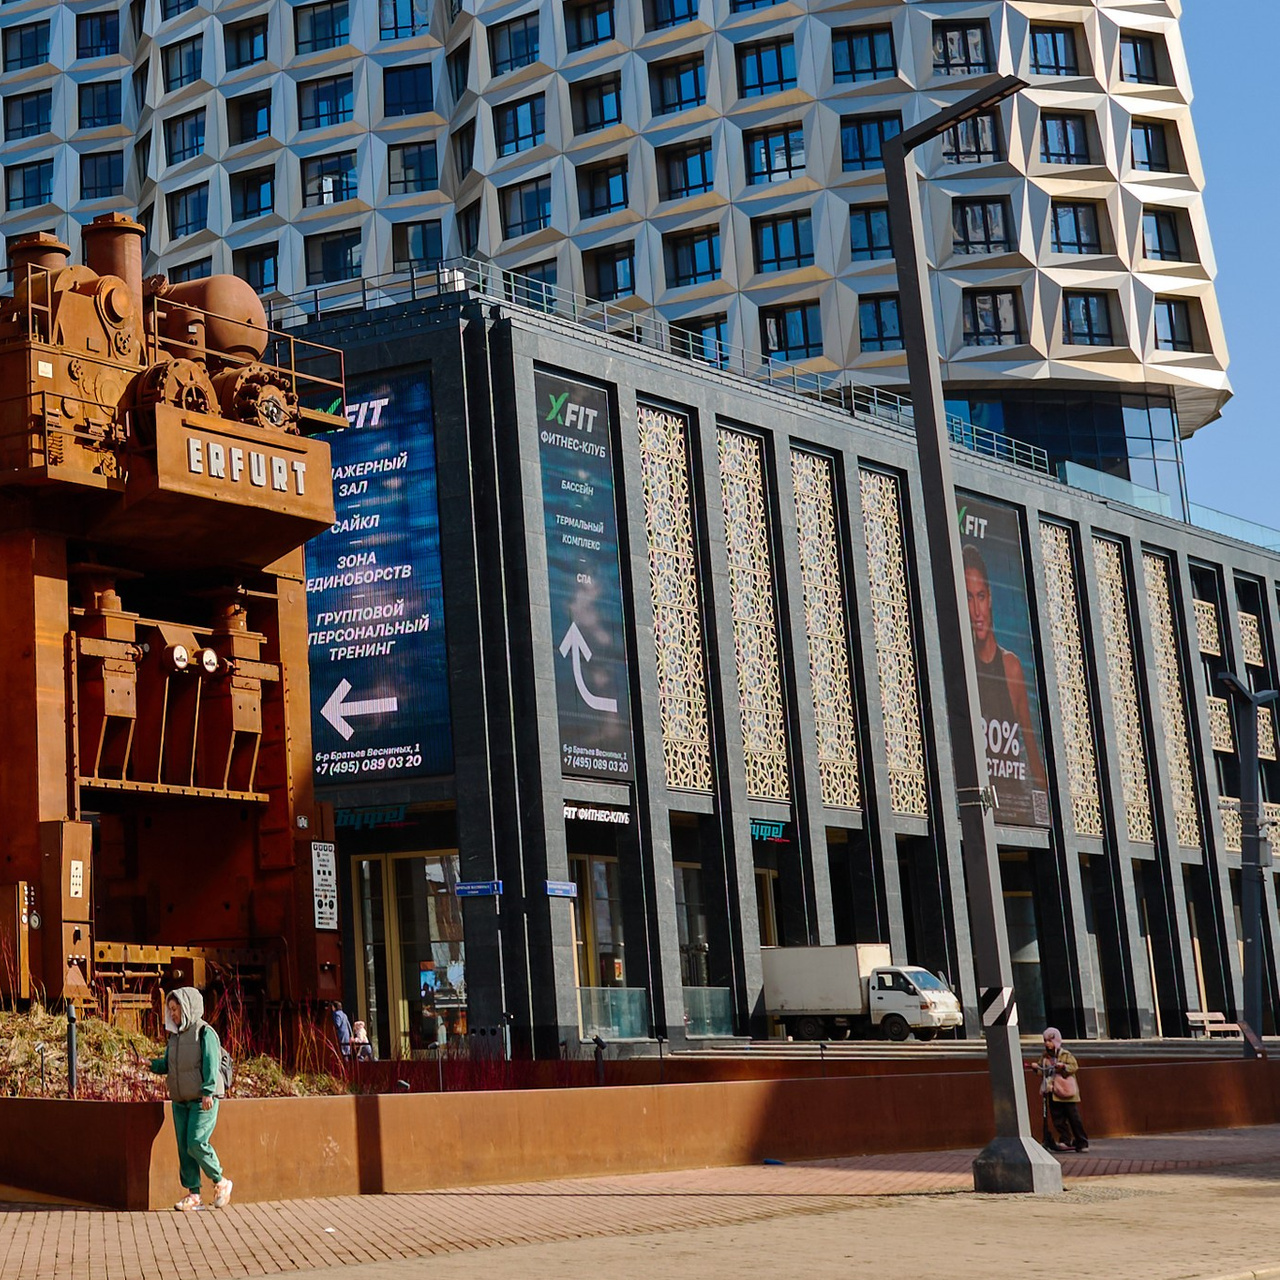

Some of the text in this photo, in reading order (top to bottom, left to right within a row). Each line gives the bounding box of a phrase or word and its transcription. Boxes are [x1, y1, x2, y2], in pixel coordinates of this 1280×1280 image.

[545, 392, 599, 433] XFIT
[540, 429, 606, 458] ФИТНЕС-КЛУБ
[187, 436, 307, 496] ERFURT
[338, 480, 369, 497] ЗАЛ
[561, 479, 594, 496] БАССЕЙН
[330, 514, 380, 534] САЙКЛ
[555, 514, 604, 534] ТЕРМАЛЬНЫЙ
[562, 533, 601, 551] КОМПЛЕКС
[336, 551, 377, 570] ЗОНА
[305, 564, 412, 593] ЕДИНОБОРСТВ
[576, 573, 592, 585] СПА
[316, 598, 404, 626] ГРУППОВОЙ
[308, 614, 430, 646] ПЕРСОНАЛЬНЫЙ
[329, 641, 396, 661] ТРЕНИНГ
[315, 743, 420, 762] б-р Братьев Весниных, 1
[315, 754, 422, 776] +7 (495) 089 03 20
[563, 755, 629, 773] +7 (495) 089 03 20
[563, 806, 630, 825] FIT ФИТНЕС-КЛУБ
